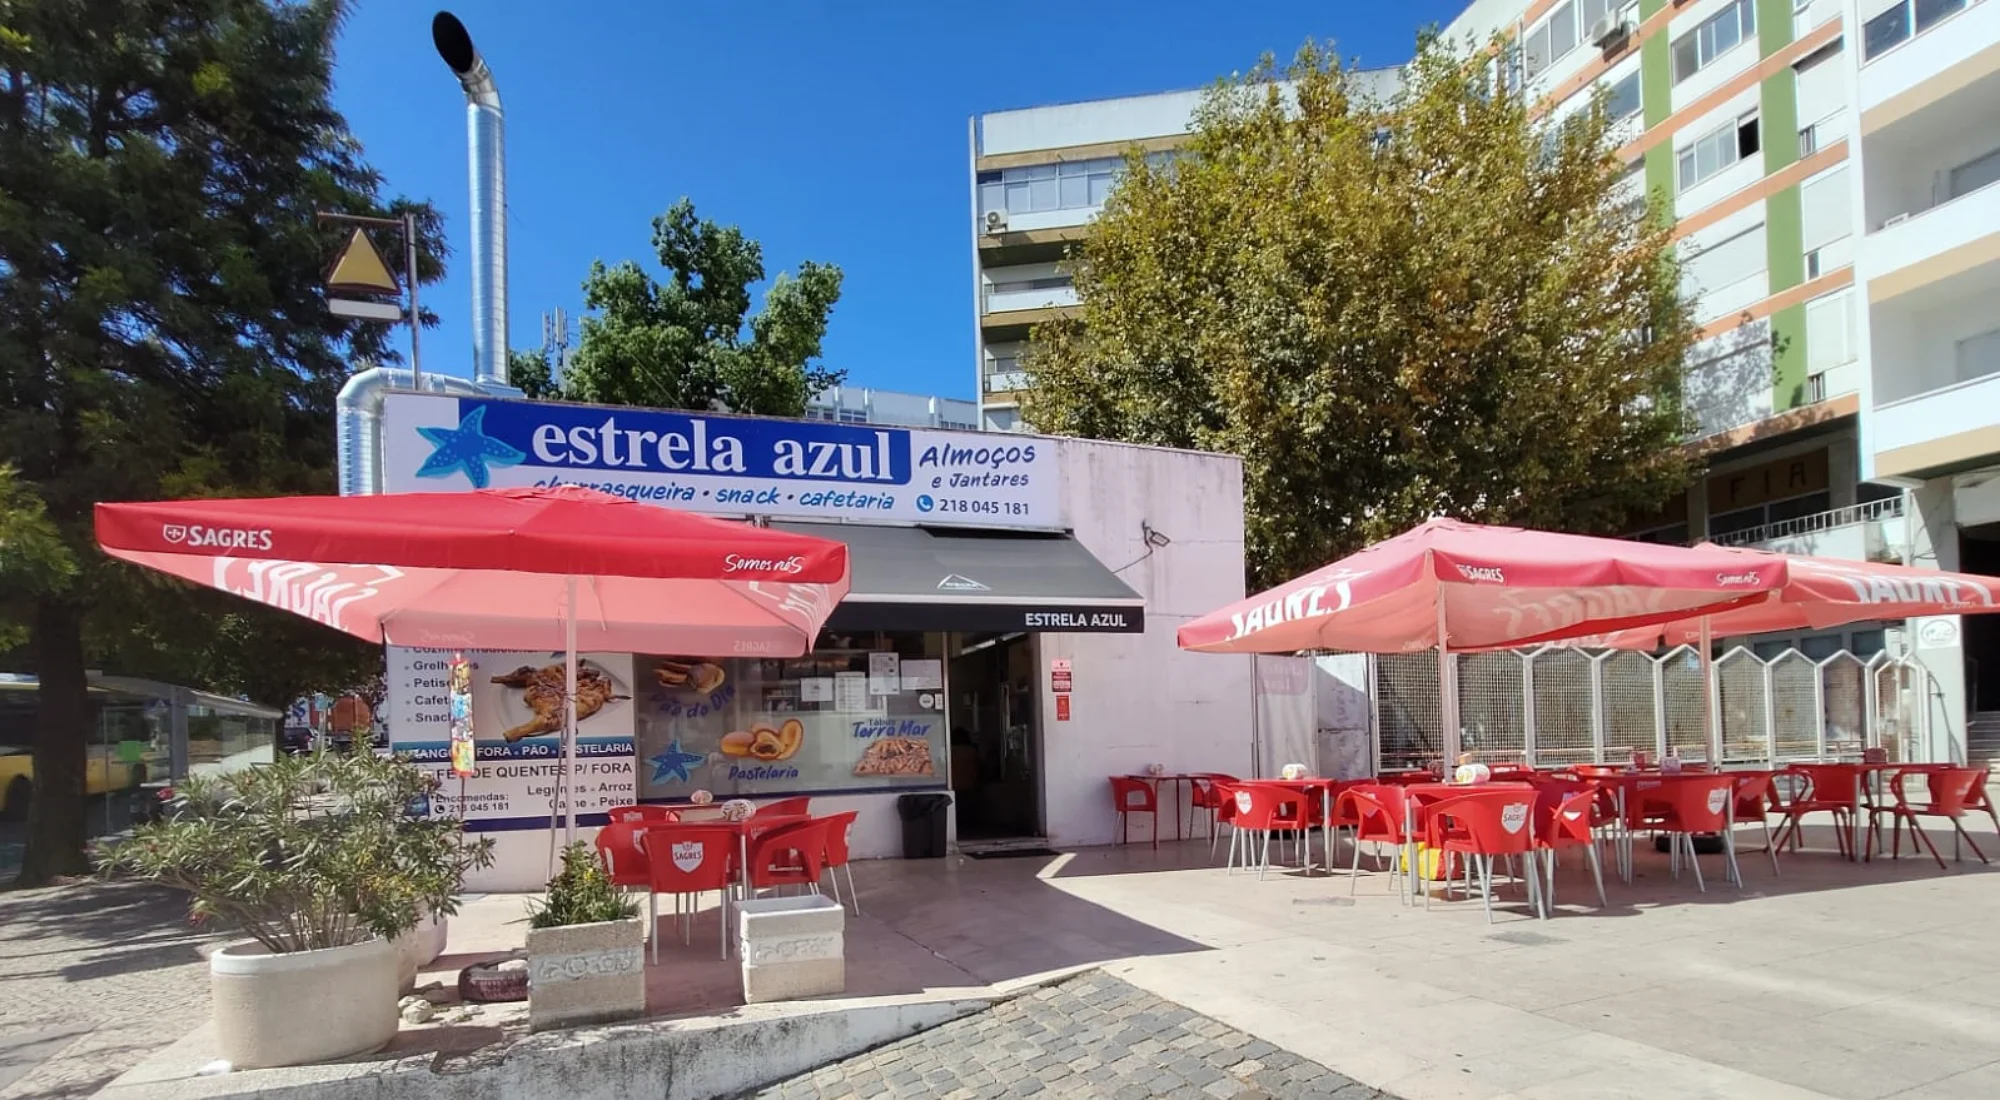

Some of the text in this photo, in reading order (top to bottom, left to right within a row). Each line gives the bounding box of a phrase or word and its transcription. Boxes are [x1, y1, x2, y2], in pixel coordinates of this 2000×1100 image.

[532, 416, 894, 480] estrela azul
[919, 442, 1036, 469] Almoços
[931, 472, 1029, 488] e Jantares
[715, 486, 781, 505] snack
[799, 490, 895, 510] cafetaria
[939, 499, 1029, 515] 218 045 181
[187, 525, 273, 550] SAGRES
[722, 553, 772, 573] Somos
[1468, 565, 1504, 583] SAGRES
[1025, 612, 1127, 627] ESTRELA AZUL
[898, 720, 932, 736] Mar
[477, 746, 511, 757] FORA
[522, 745, 548, 755] PÃO
[592, 763, 632, 774] FORA
[728, 765, 799, 780] Pastelaria
[599, 782, 632, 792] Arroz
[470, 803, 489, 811] 045
[492, 802, 509, 810] 181
[600, 796, 633, 806] Peixe
